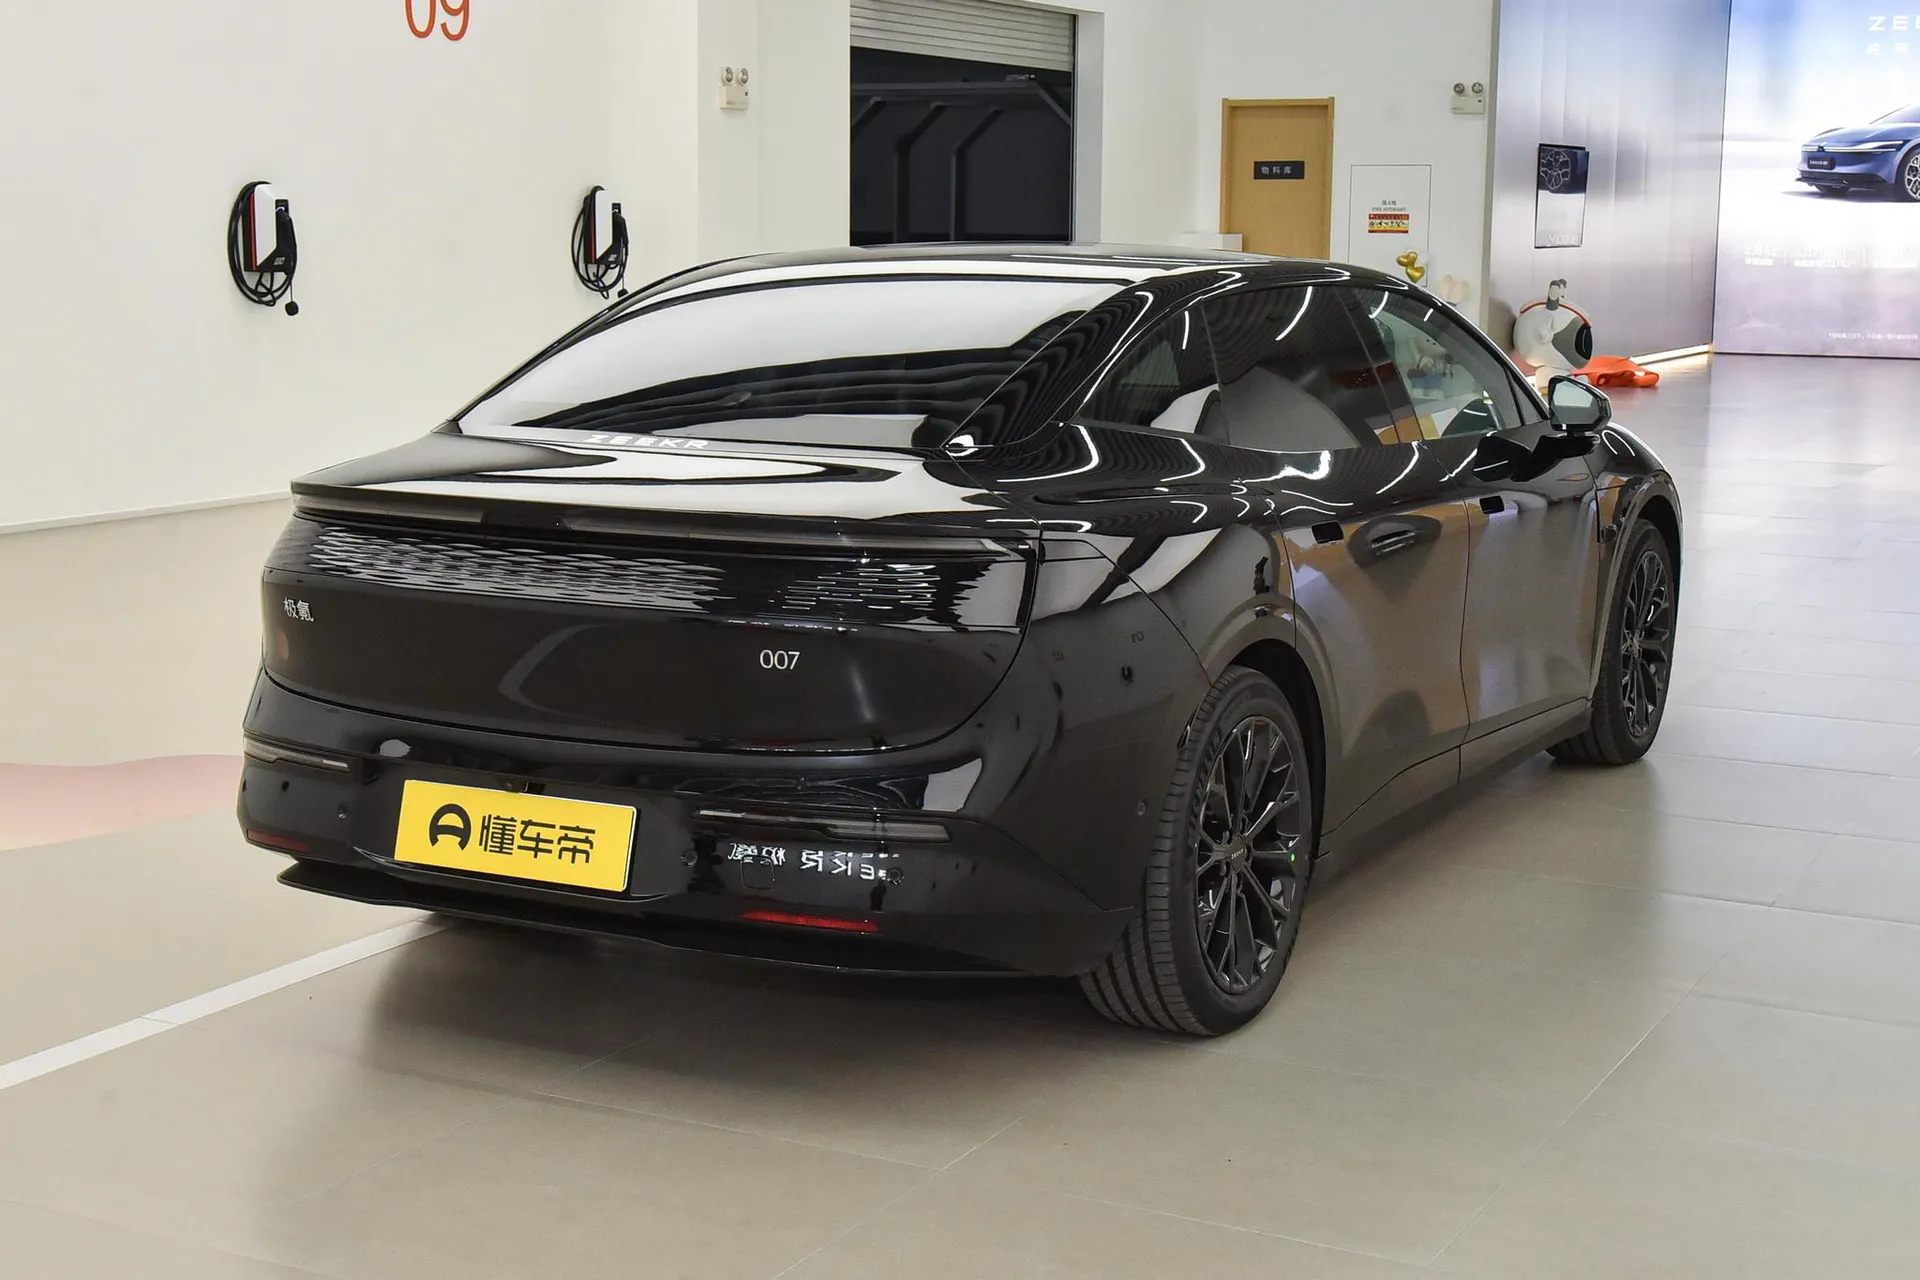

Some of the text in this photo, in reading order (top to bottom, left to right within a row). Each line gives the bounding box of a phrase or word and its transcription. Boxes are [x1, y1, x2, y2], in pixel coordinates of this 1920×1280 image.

[405, 0, 470, 41] 09
[1261, 165, 1292, 175] 物料库
[585, 434, 708, 449] ZEEKR
[284, 597, 314, 622] 极氪
[760, 650, 800, 670] 007
[479, 814, 596, 864] 懂车帝
